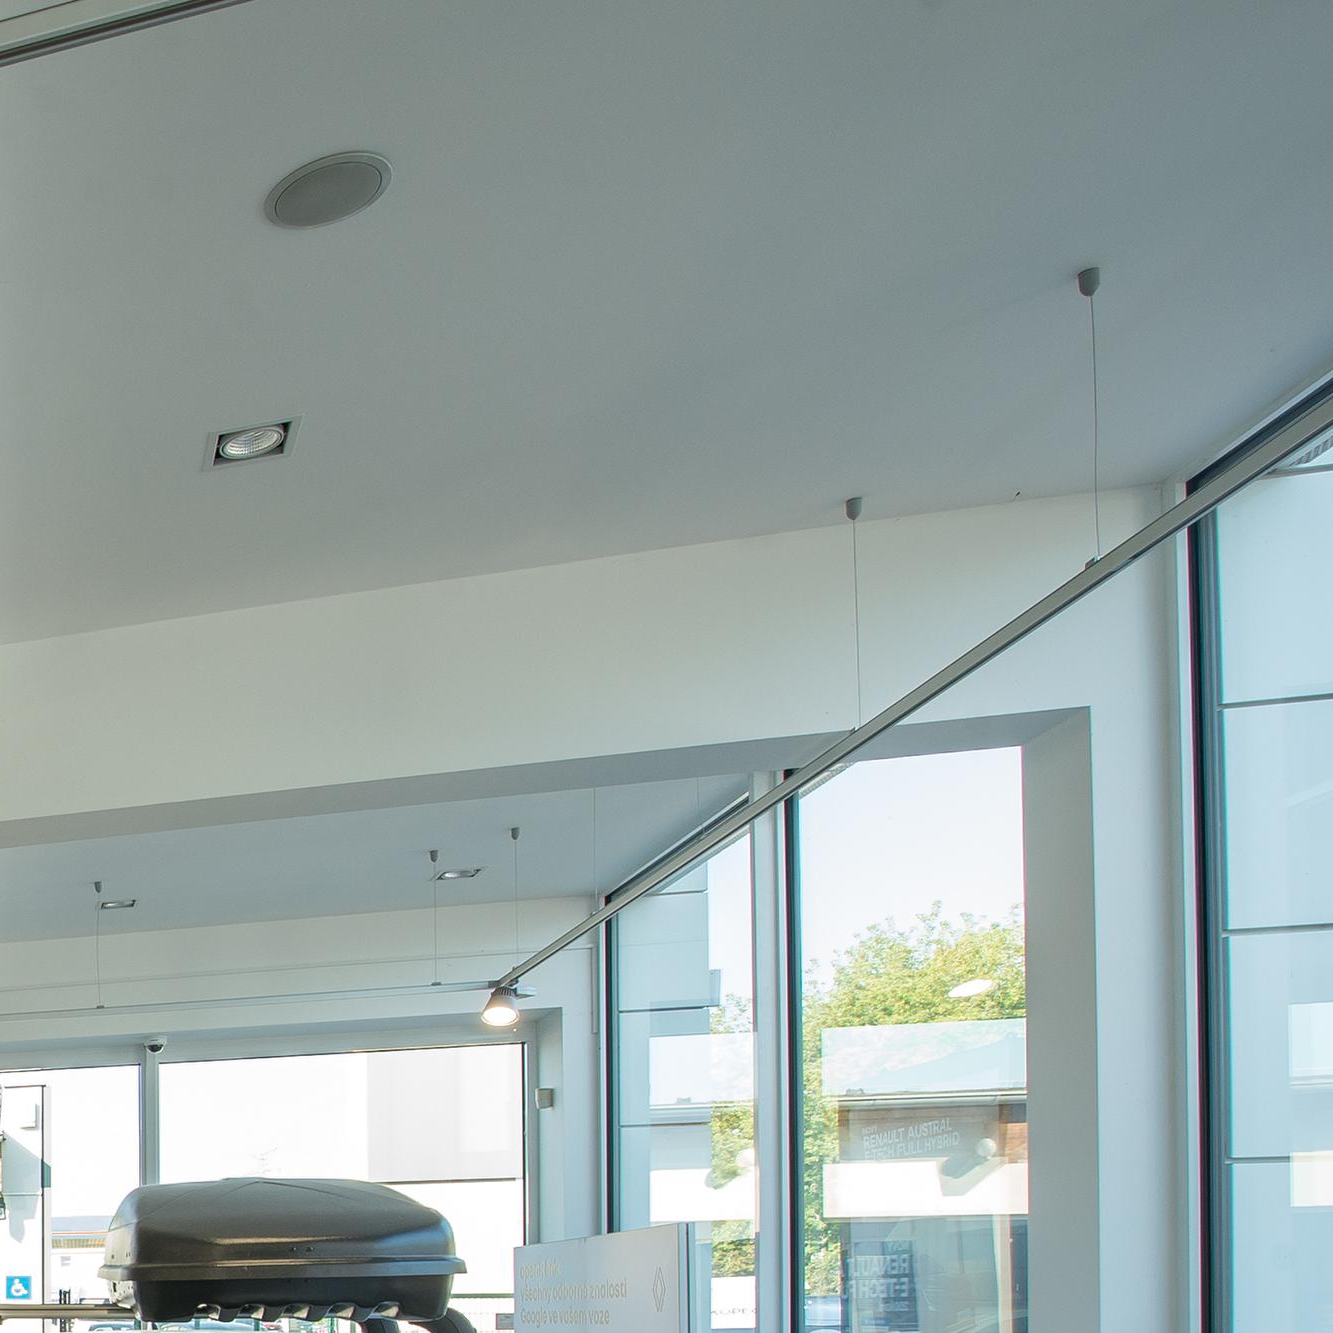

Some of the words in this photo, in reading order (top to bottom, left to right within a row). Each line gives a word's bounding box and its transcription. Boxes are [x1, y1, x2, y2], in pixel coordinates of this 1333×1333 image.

[863, 1128, 905, 1149] RENAULT
[907, 1117, 952, 1140] AUSTRAL
[924, 1132, 960, 1153] HYBRID
[520, 1307, 547, 1328] Google
[589, 1310, 610, 1325] voze
